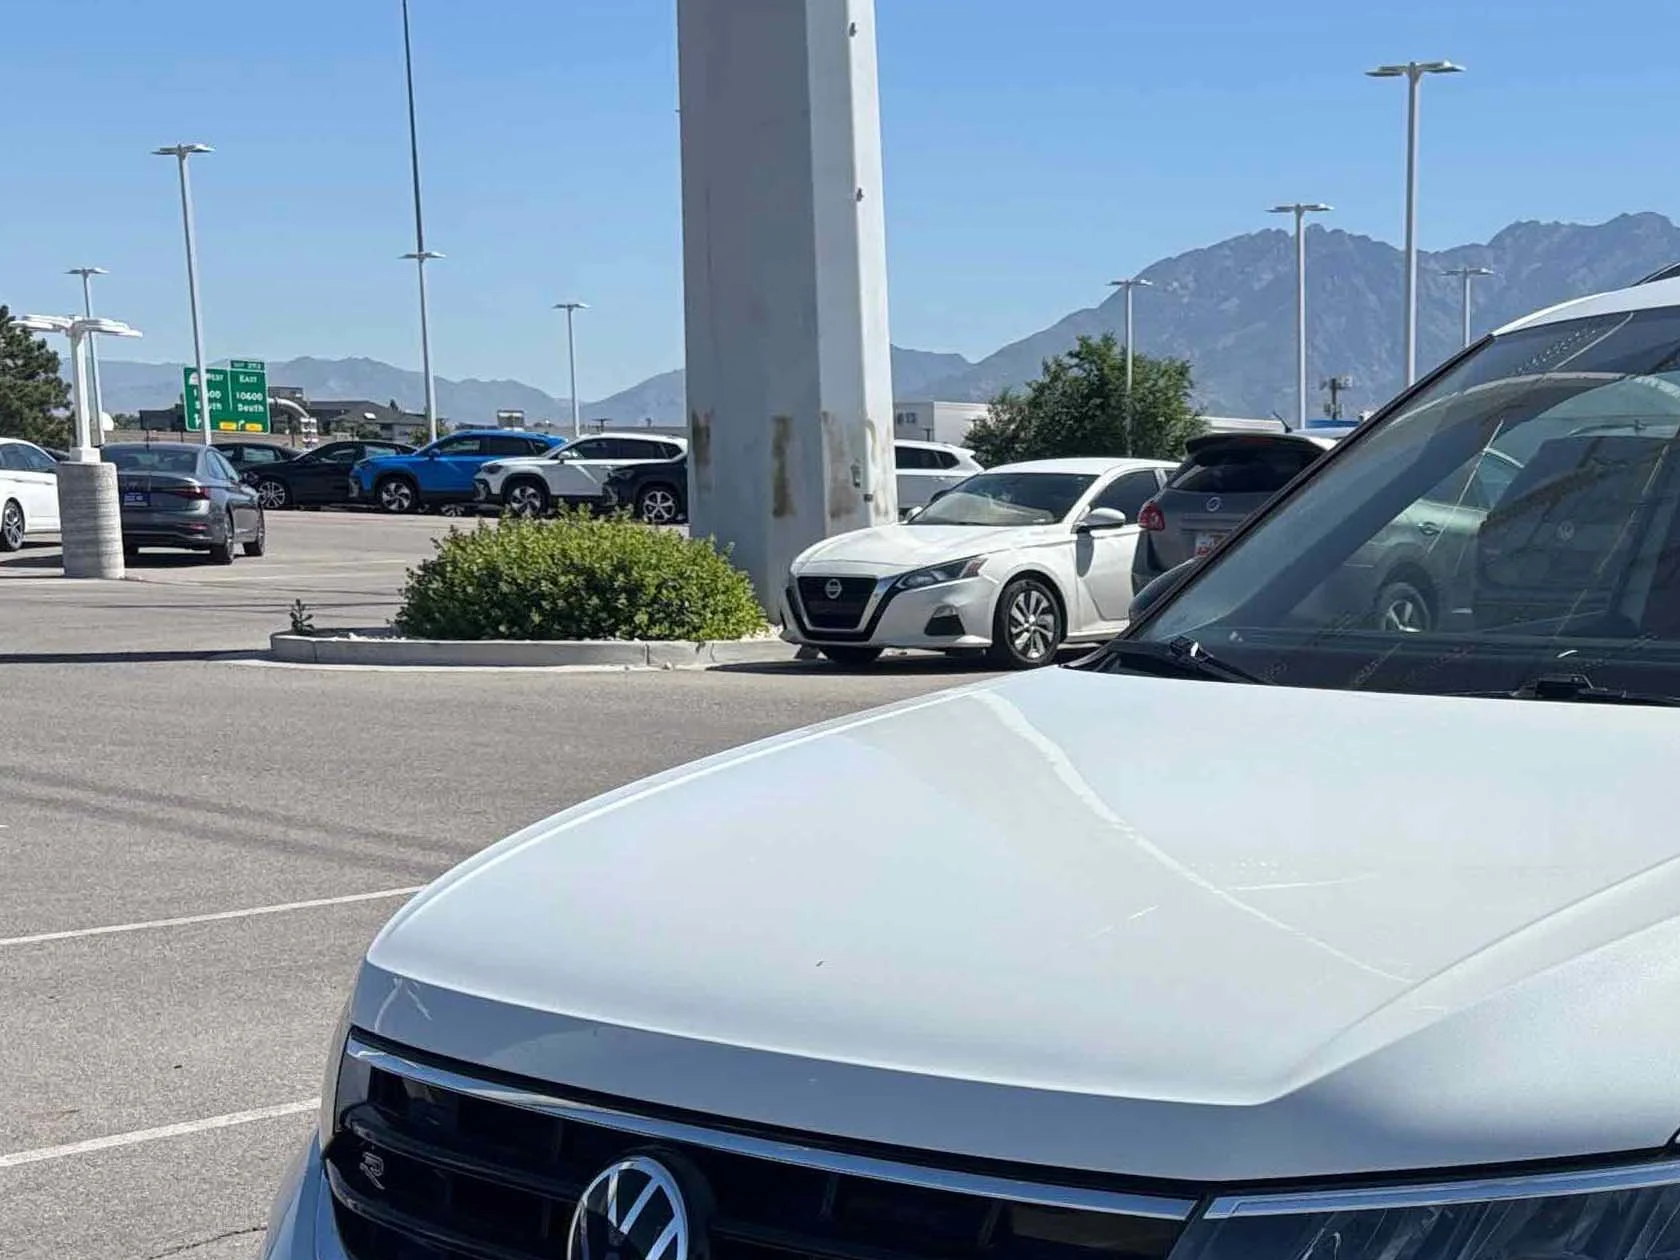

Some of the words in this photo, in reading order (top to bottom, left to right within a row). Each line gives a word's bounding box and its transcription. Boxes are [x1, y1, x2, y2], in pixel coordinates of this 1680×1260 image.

[239, 374, 257, 383] EAST
[236, 391, 263, 401] 10600
[237, 403, 264, 413] South
